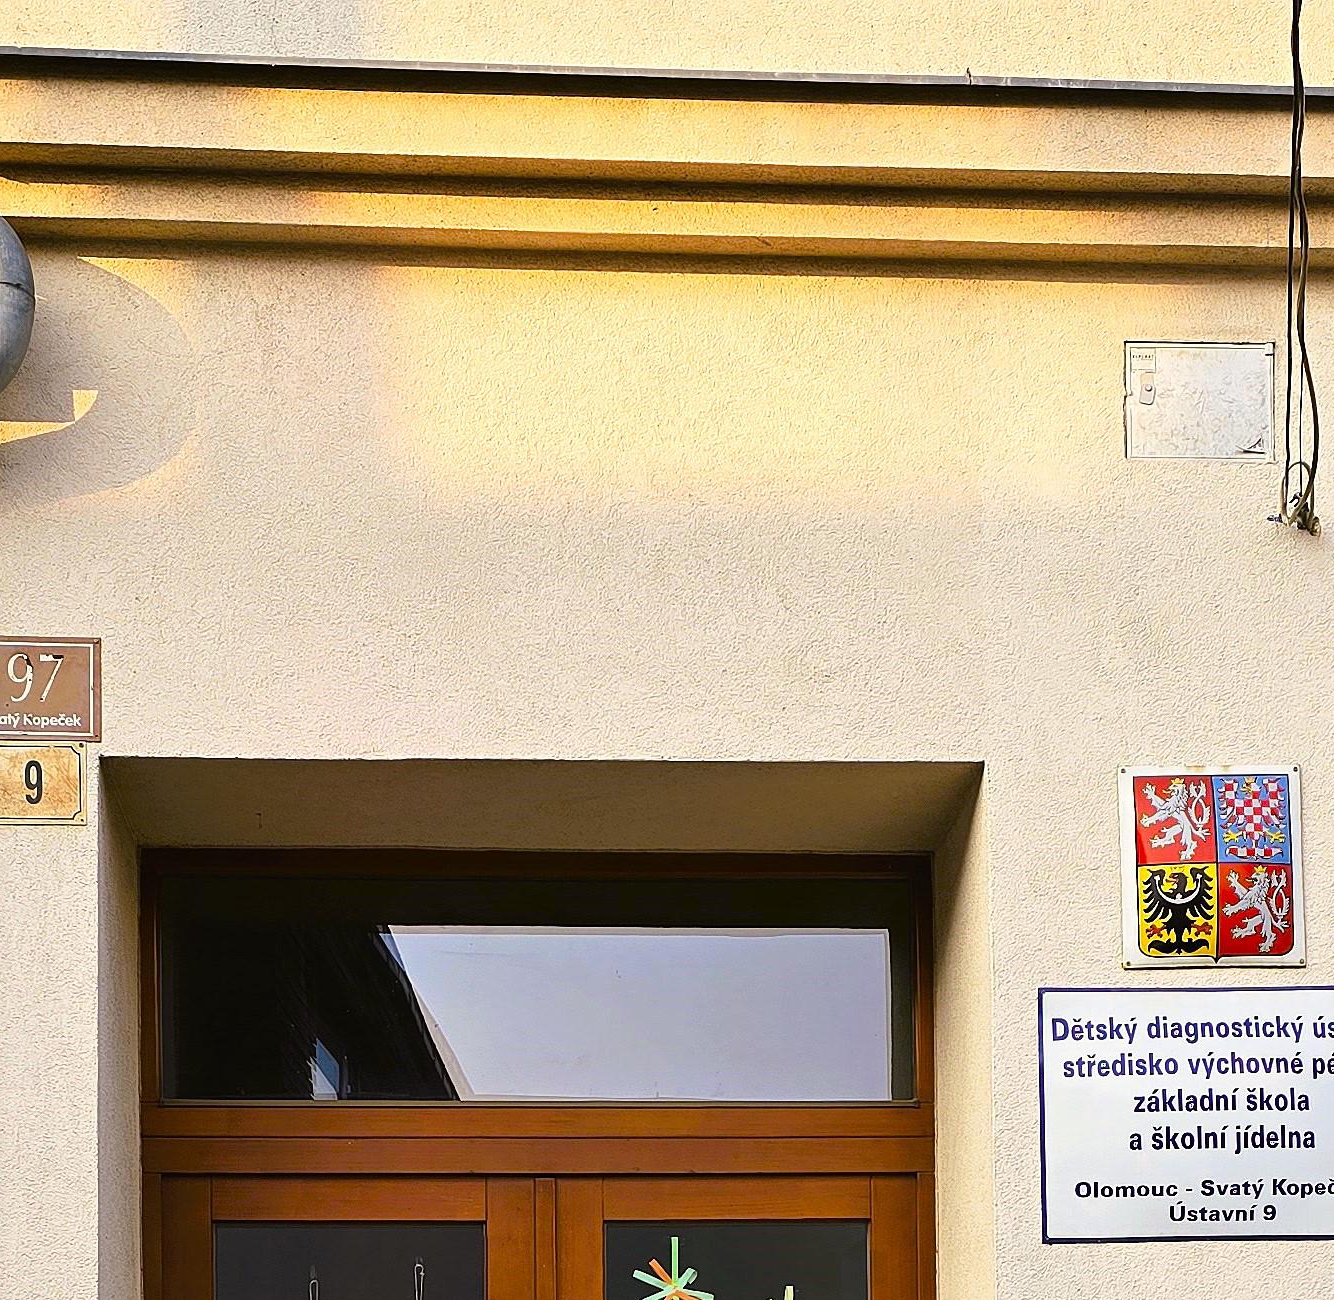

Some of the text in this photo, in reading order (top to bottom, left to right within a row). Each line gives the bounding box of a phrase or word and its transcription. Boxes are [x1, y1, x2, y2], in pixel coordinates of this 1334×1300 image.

[6, 653, 64, 703] 97
[24, 714, 82, 728] Kopeček
[25, 760, 43, 804] 9
[1051, 1017, 1137, 1044] Dětský
[1147, 1016, 1303, 1044] diagnostický
[1063, 1053, 1178, 1078] středisko
[1188, 1052, 1303, 1079] výchovné
[1133, 1088, 1310, 1113] základní škola
[1129, 1125, 1316, 1154] a školní jídelna
[1075, 1181, 1178, 1198] Olomouc
[1201, 1178, 1264, 1197] Svatý
[1169, 1200, 1276, 1222] Ústavní 9
